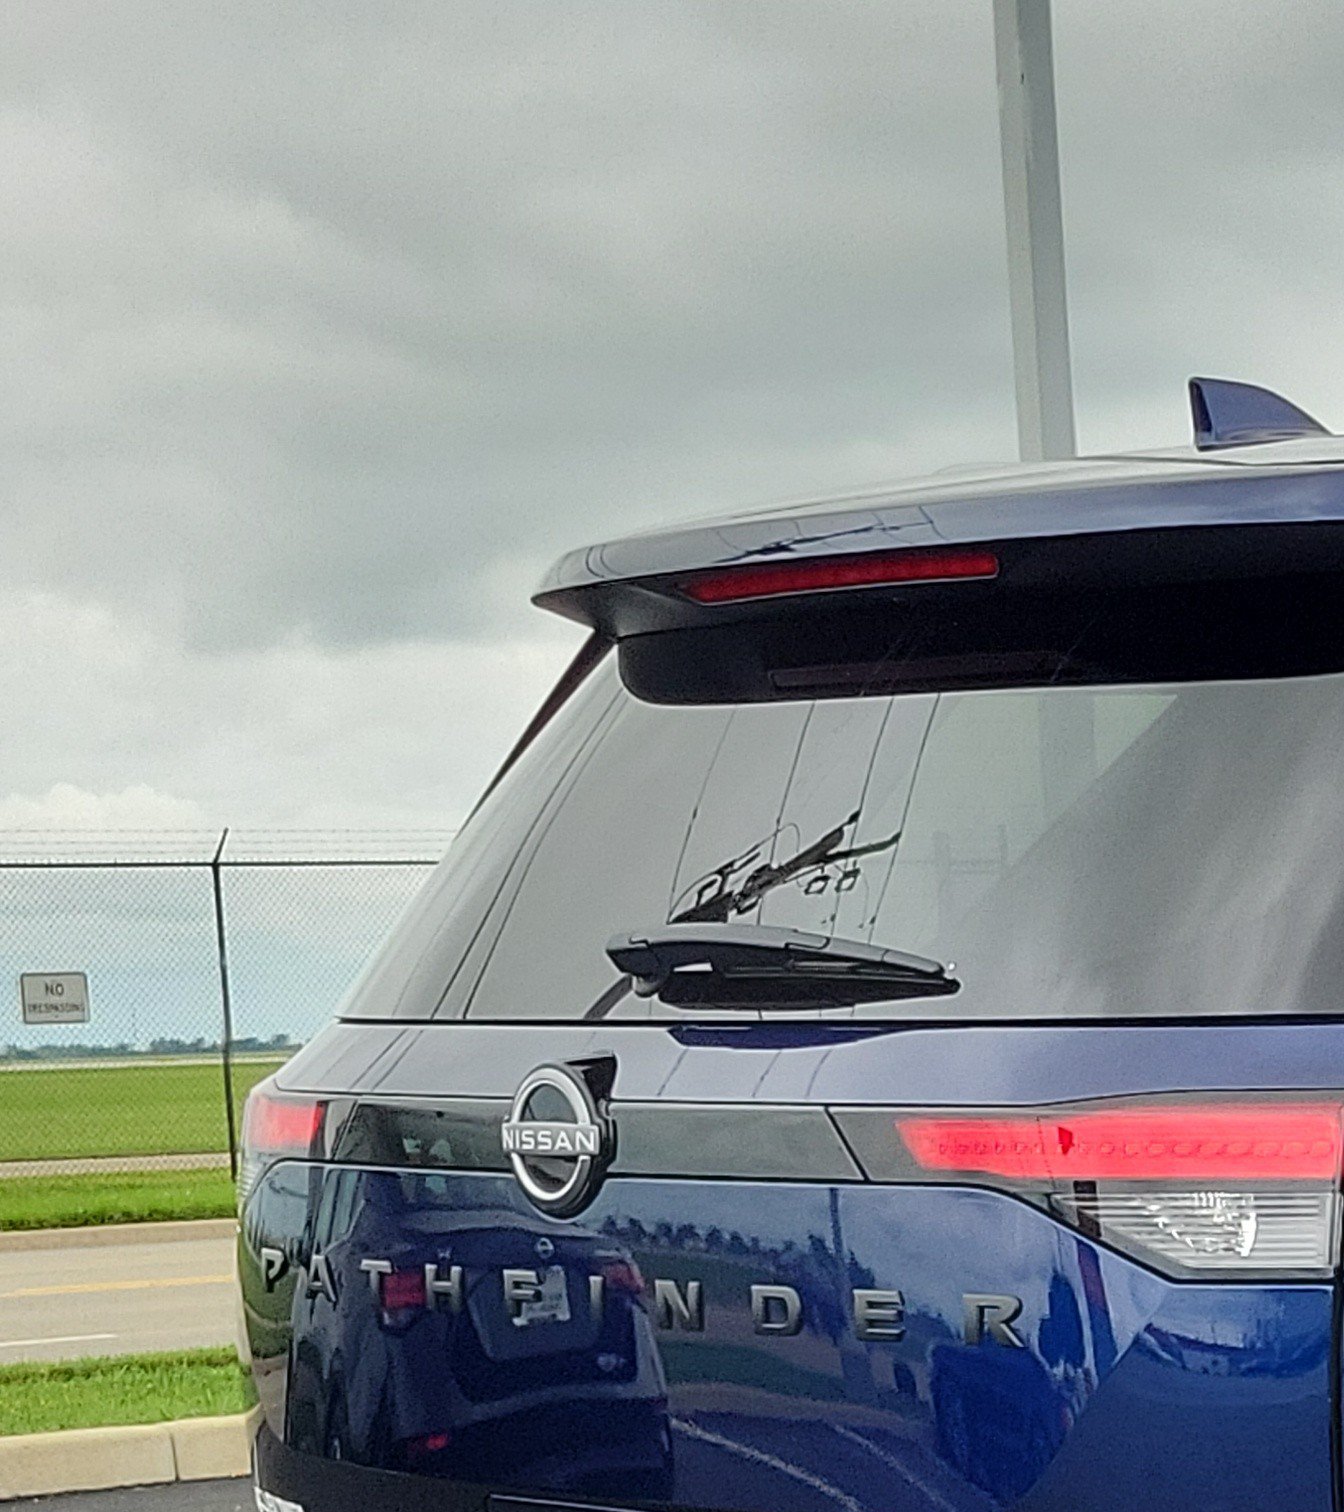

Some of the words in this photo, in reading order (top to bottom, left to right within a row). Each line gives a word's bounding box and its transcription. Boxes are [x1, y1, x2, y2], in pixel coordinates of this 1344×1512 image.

[44, 982, 65, 997] NO
[502, 1129, 596, 1151] NISSAN
[260, 1247, 1028, 1348] PATHFINDER
